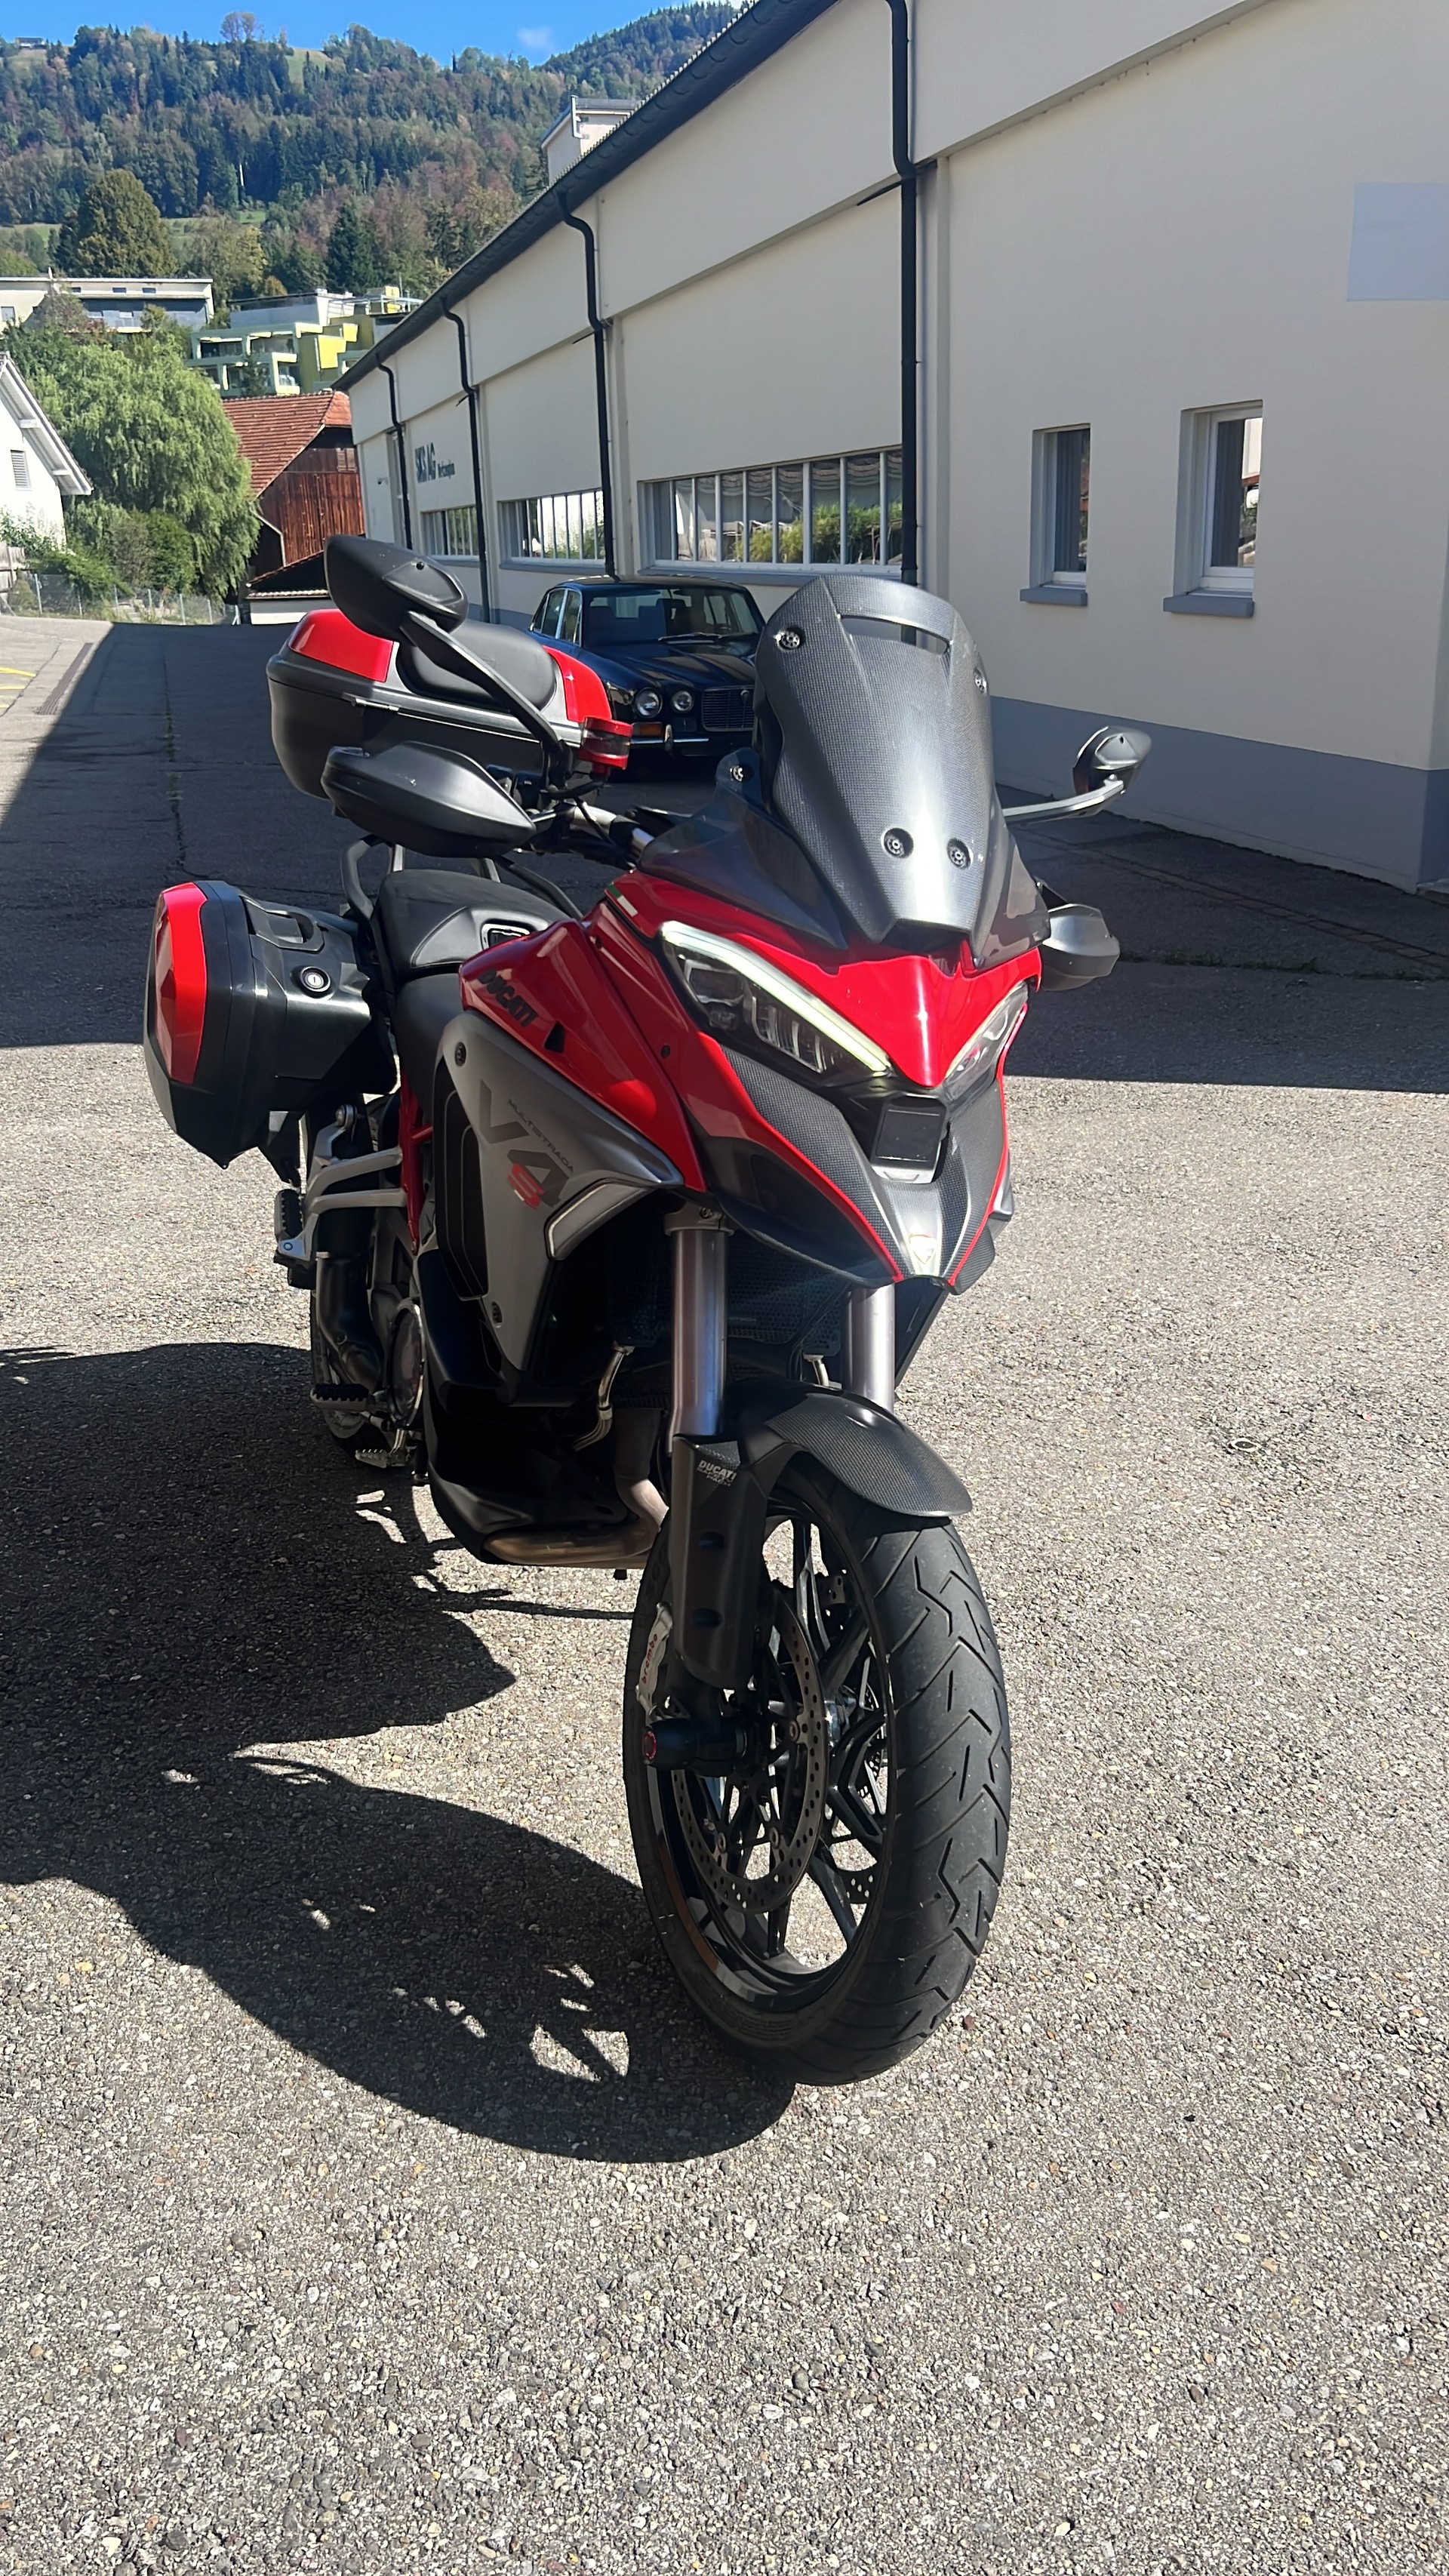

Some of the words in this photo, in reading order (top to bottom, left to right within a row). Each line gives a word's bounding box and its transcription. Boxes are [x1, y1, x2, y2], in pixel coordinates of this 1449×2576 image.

[427, 442, 436, 481] AG
[478, 968, 538, 1027] DUCATI
[508, 1099, 574, 1172] MULTISTRADA
[698, 1460, 737, 1480] DUCATI
[641, 1633, 658, 1685] brembo
